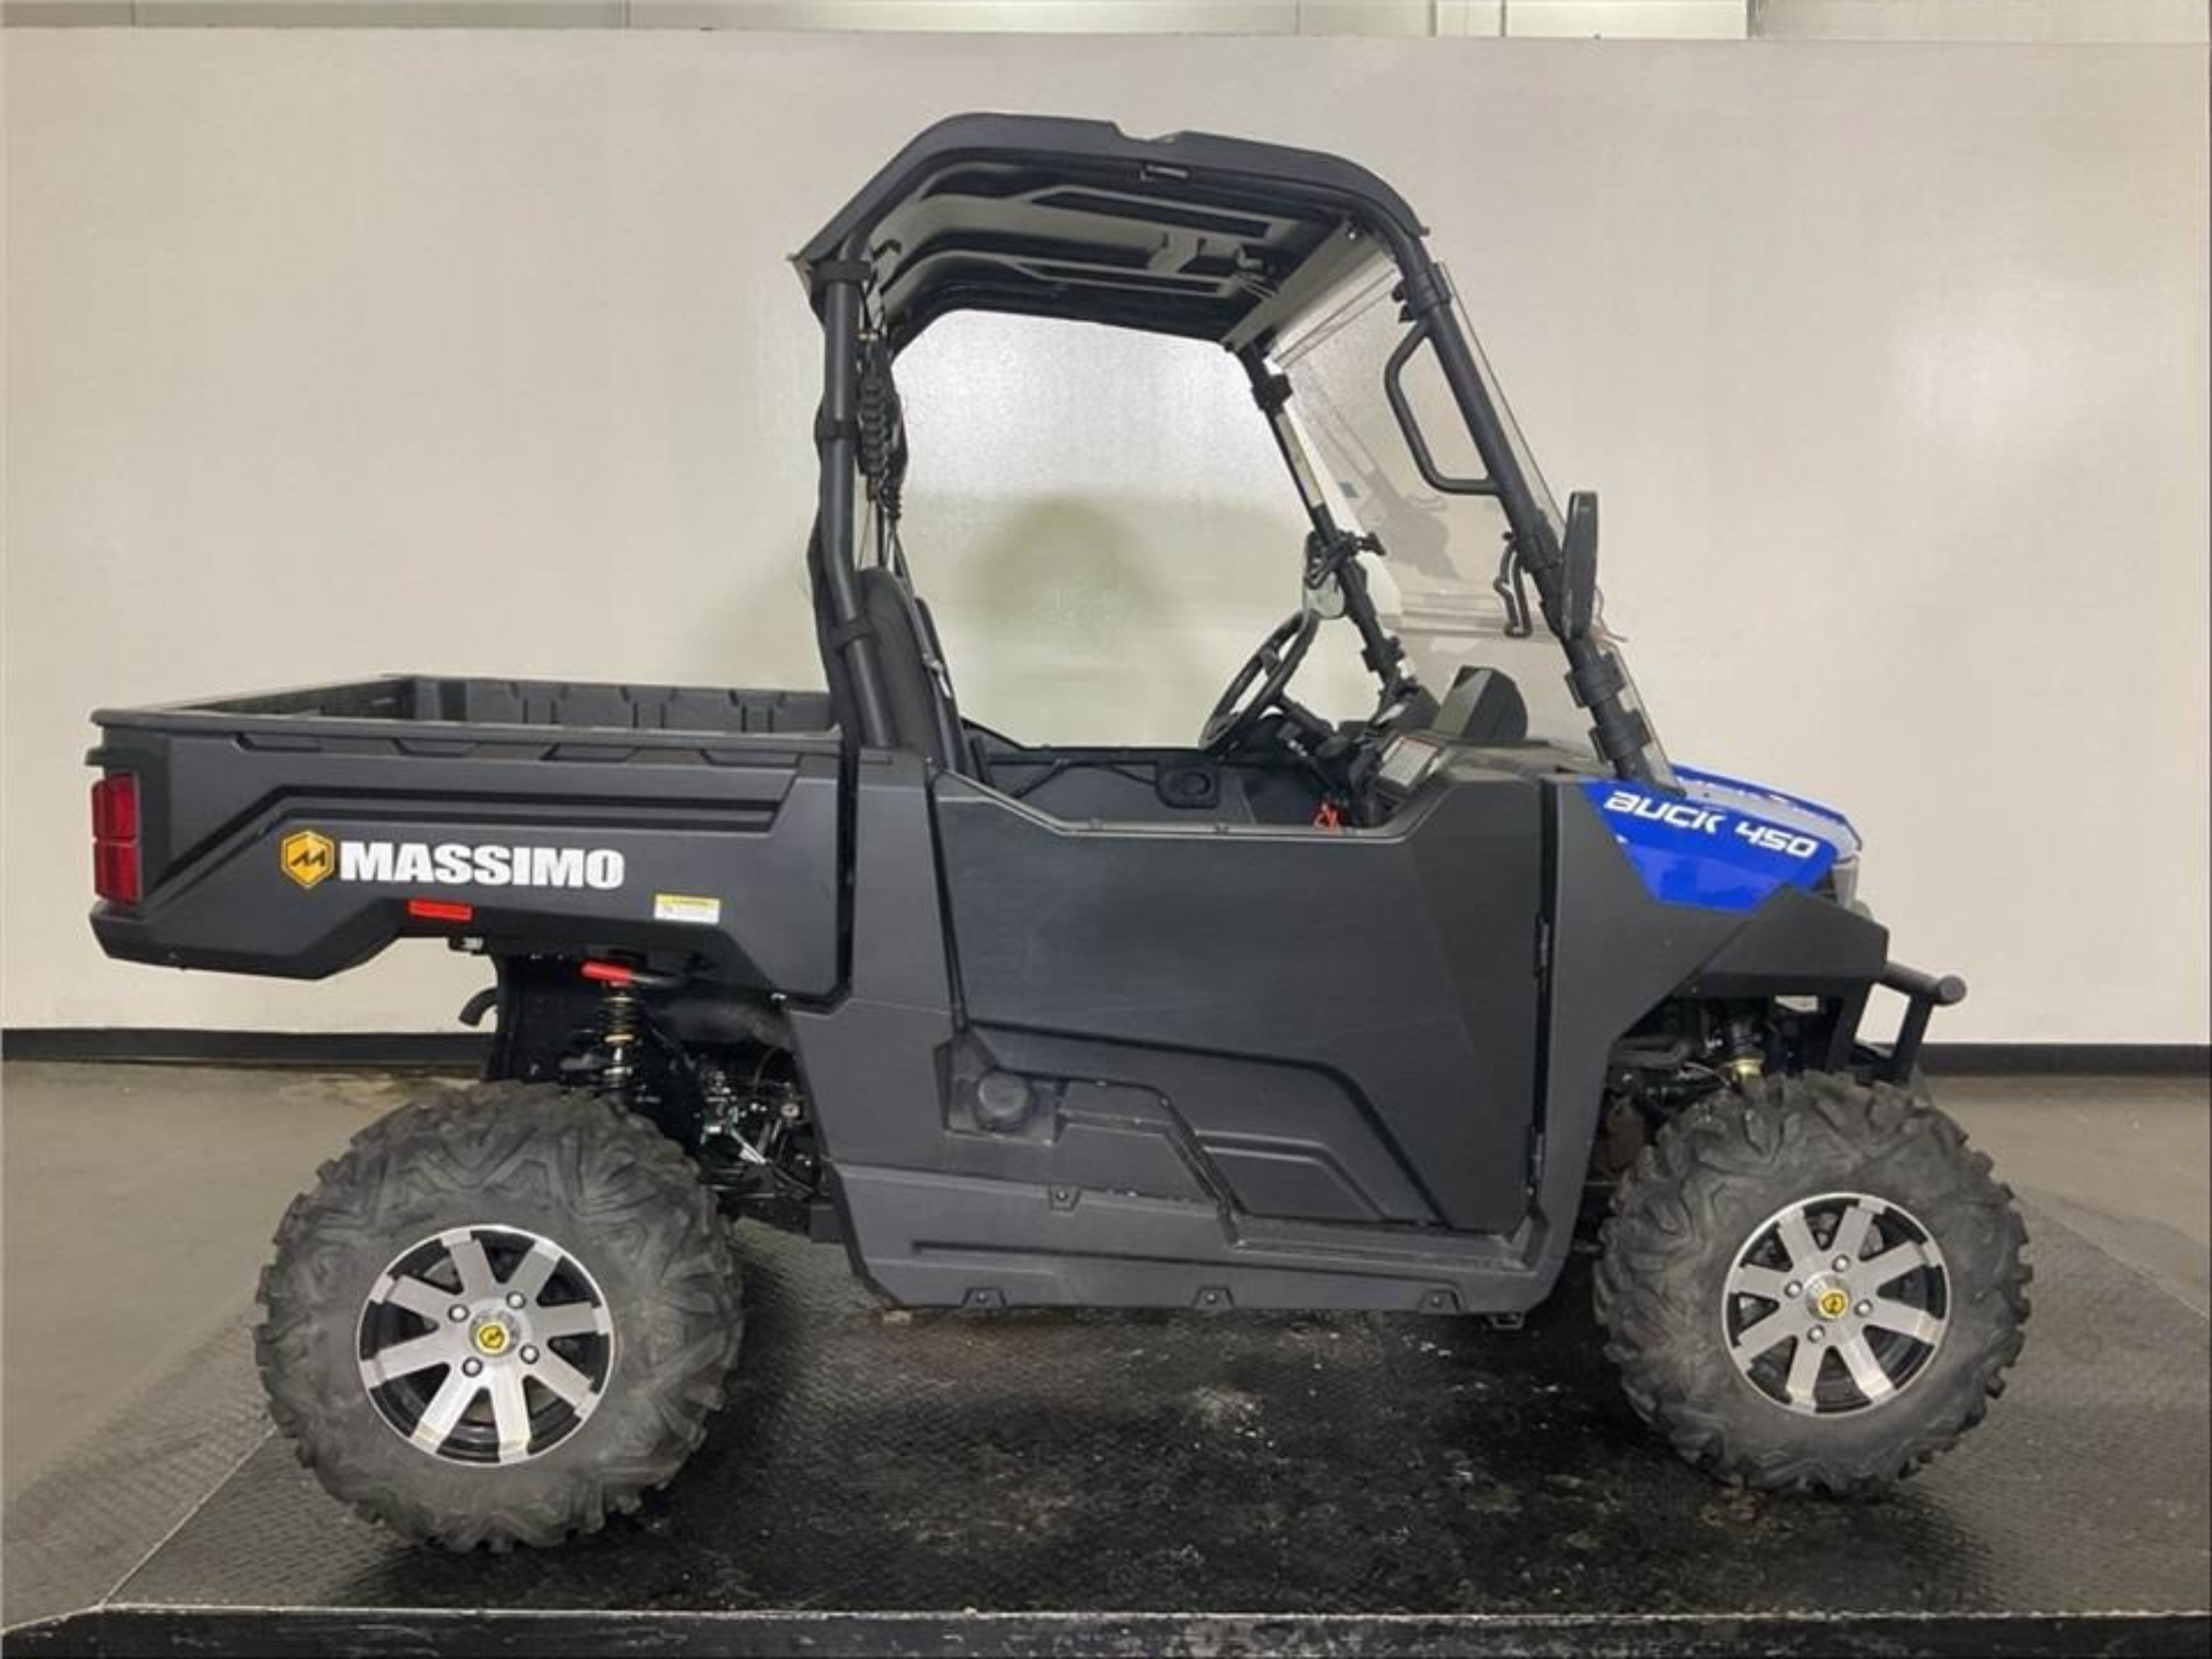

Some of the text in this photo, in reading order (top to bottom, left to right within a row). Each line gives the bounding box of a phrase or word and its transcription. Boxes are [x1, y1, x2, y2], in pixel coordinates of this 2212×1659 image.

[1603, 790, 1819, 858] BUCK 450
[340, 840, 625, 890] MASSIMO
